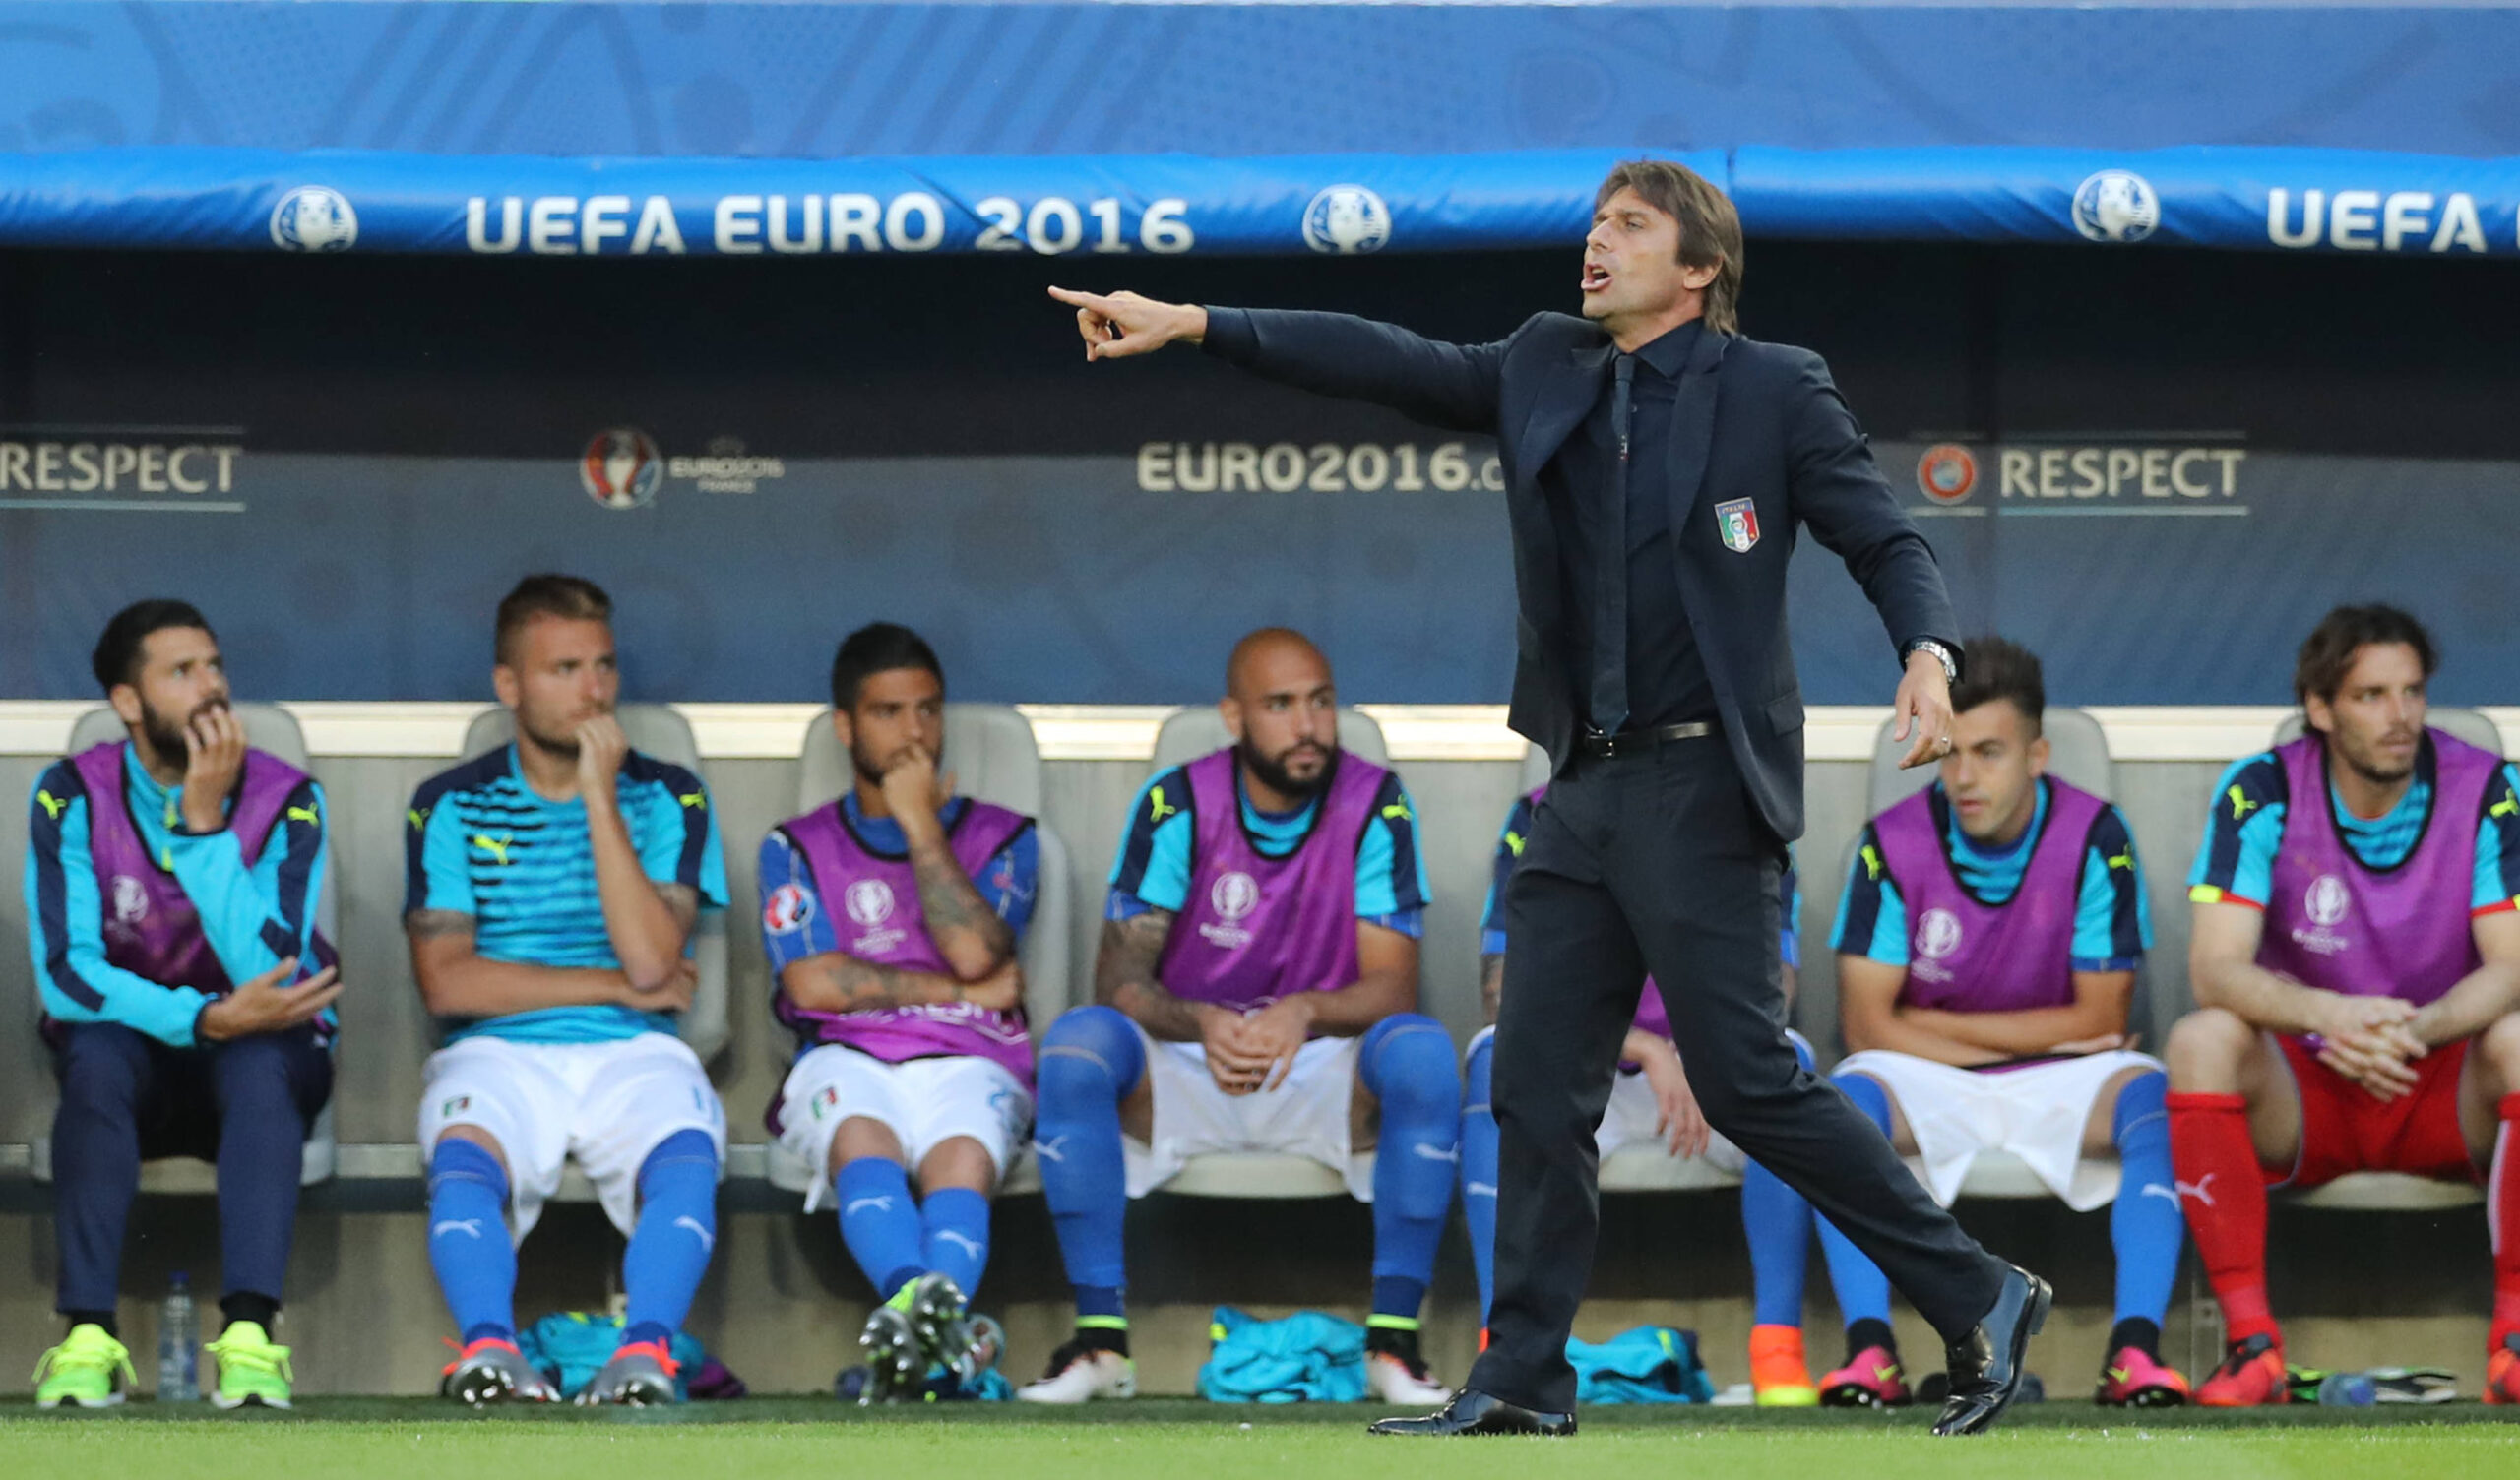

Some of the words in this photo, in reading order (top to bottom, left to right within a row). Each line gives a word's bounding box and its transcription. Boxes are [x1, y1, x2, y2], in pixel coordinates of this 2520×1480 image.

[466, 194, 688, 255] UEFA
[713, 191, 946, 255] EURO
[974, 196, 1195, 256] 2016
[2267, 187, 2488, 253] UEFA
[0, 442, 243, 493] RESPECT
[1999, 447, 2246, 499] RESPECT
